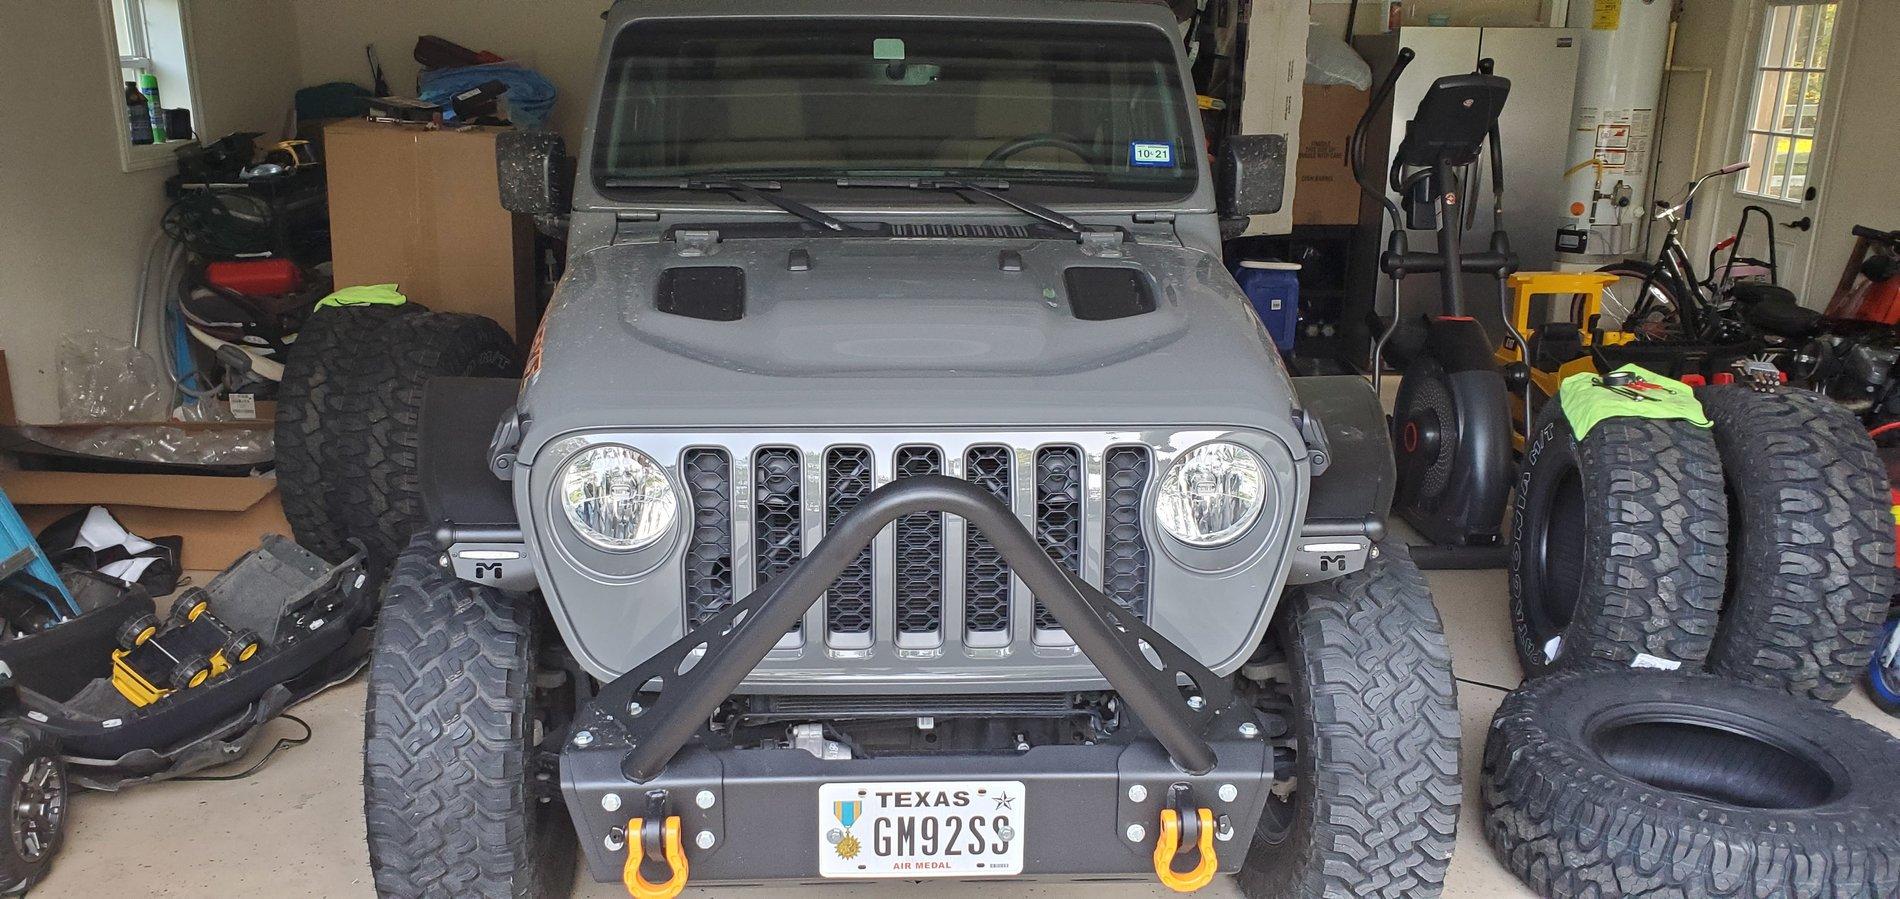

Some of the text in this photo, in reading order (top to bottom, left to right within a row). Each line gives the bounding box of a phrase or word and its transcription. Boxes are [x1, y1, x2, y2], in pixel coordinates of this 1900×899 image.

[1137, 149, 1167, 158] 10 21
[875, 790, 970, 808] TEXAS
[873, 815, 1010, 857] GM92SS
[892, 862, 912, 870] AIR
